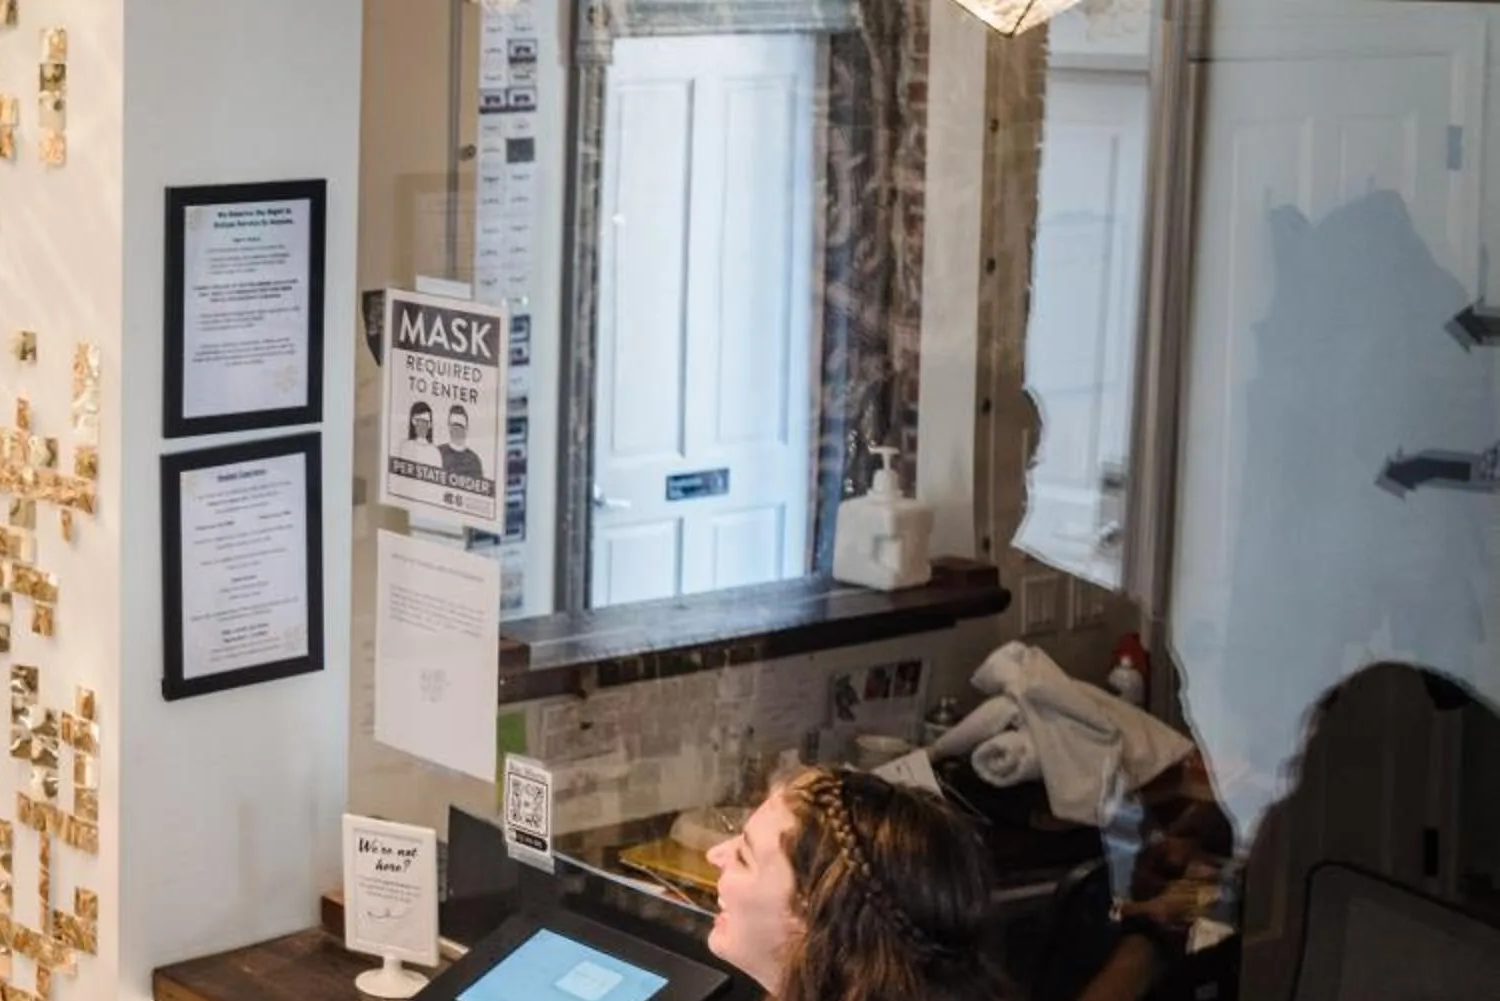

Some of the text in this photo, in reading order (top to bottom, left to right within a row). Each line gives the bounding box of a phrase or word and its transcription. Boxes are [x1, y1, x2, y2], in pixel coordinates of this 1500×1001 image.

[399, 307, 493, 359] MASK
[405, 354, 483, 383] REQUIRED
[407, 374, 479, 405] TO ENTER
[393, 459, 491, 495] PER STATE ORDER
[375, 857, 412, 874] here?
[397, 847, 418, 857] not
